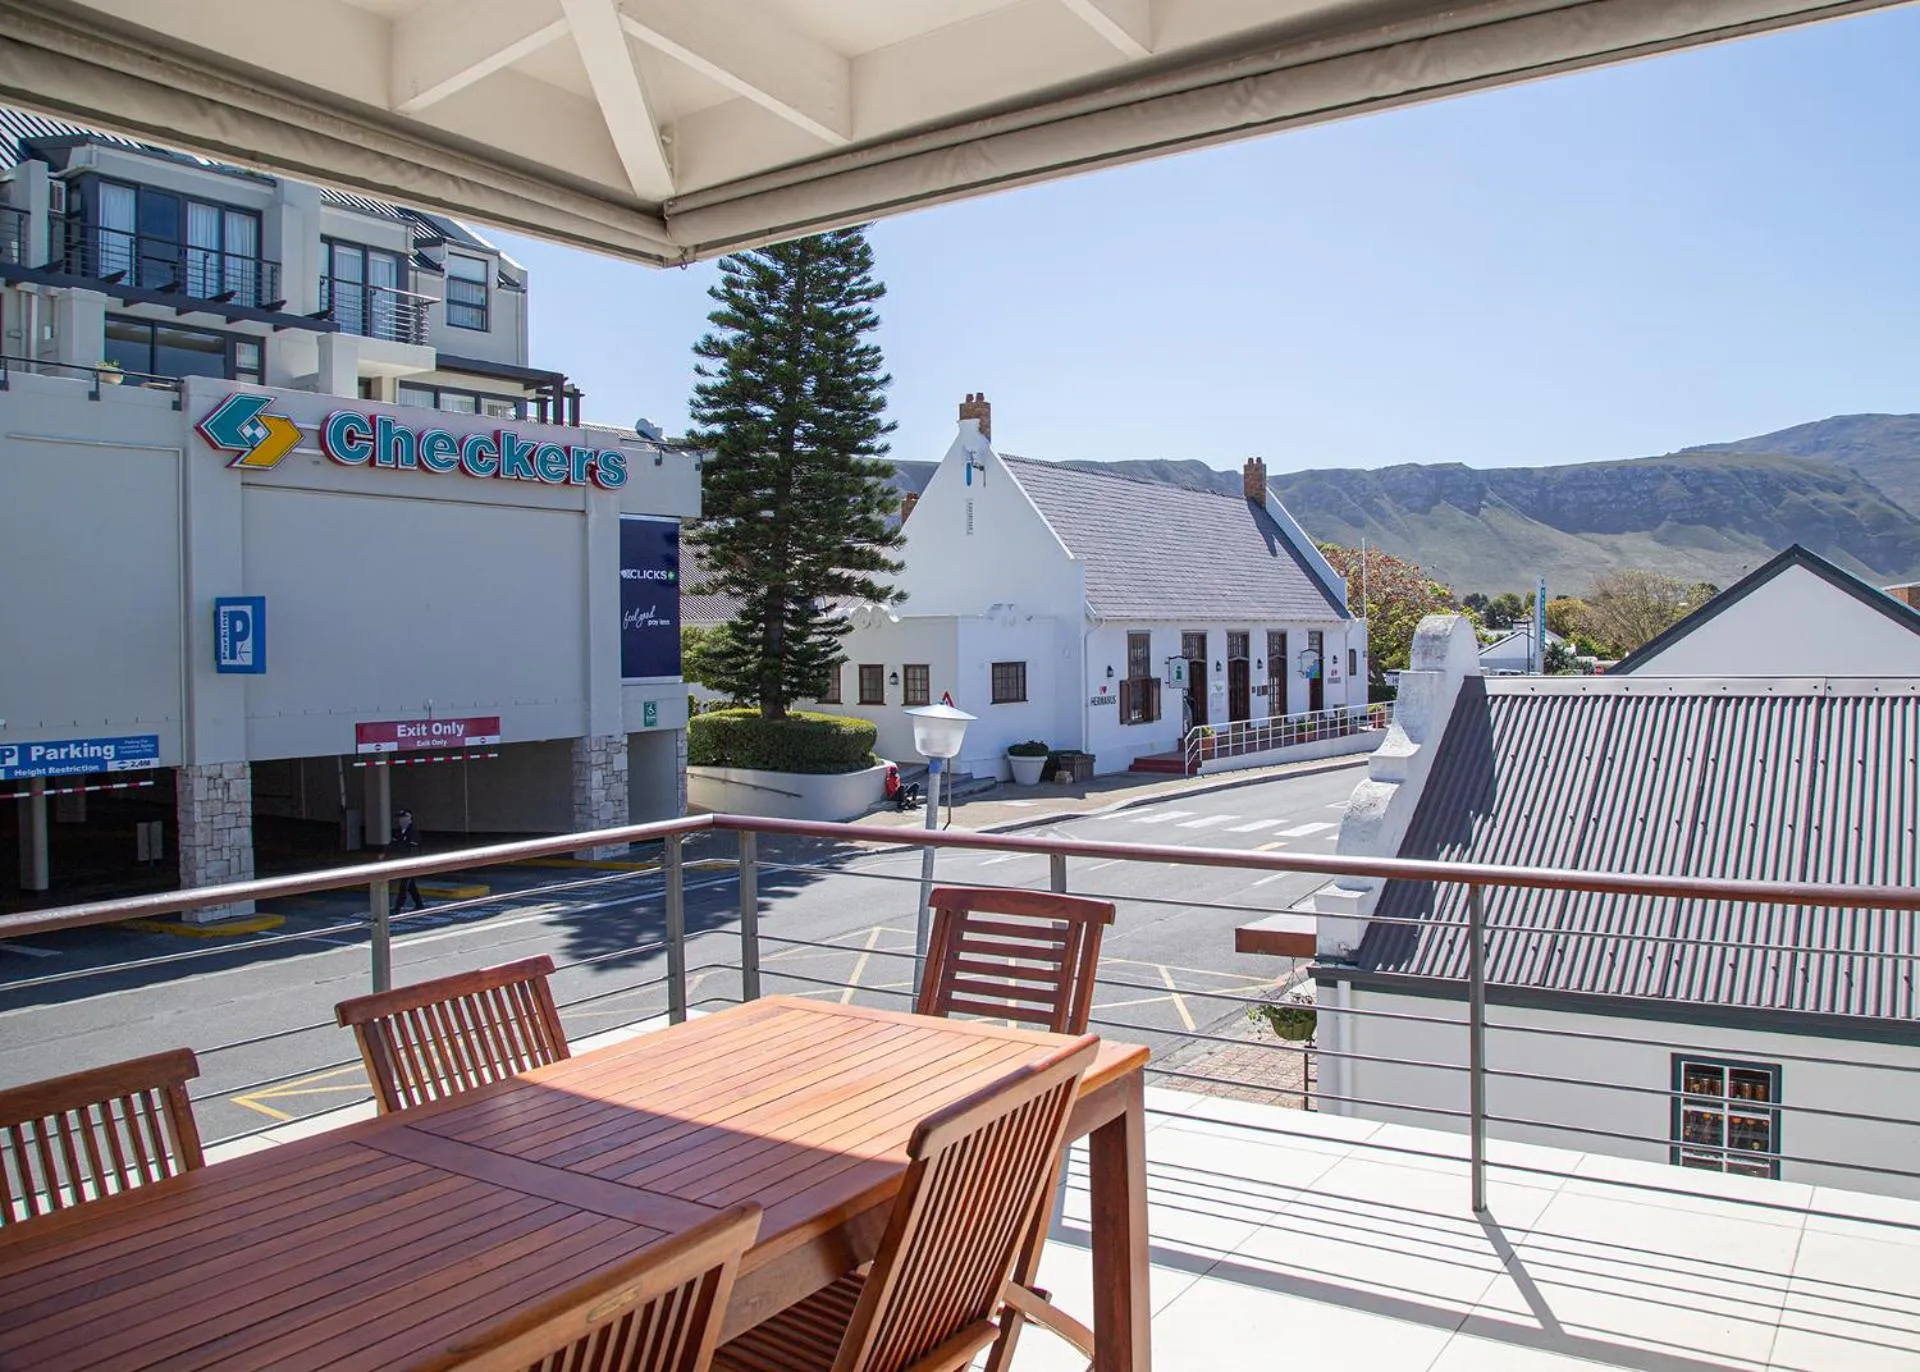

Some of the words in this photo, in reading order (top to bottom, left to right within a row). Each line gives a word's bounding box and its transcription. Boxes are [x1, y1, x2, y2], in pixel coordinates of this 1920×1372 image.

[320, 408, 629, 490] Checkers
[630, 569, 667, 580] CLICKS
[397, 723, 427, 738] Exit
[431, 721, 465, 737] Only
[416, 740, 429, 748] Exit
[431, 738, 447, 747] Only
[31, 742, 115, 761] Parking
[14, 767, 46, 777] Height
[49, 763, 99, 774] Restriction
